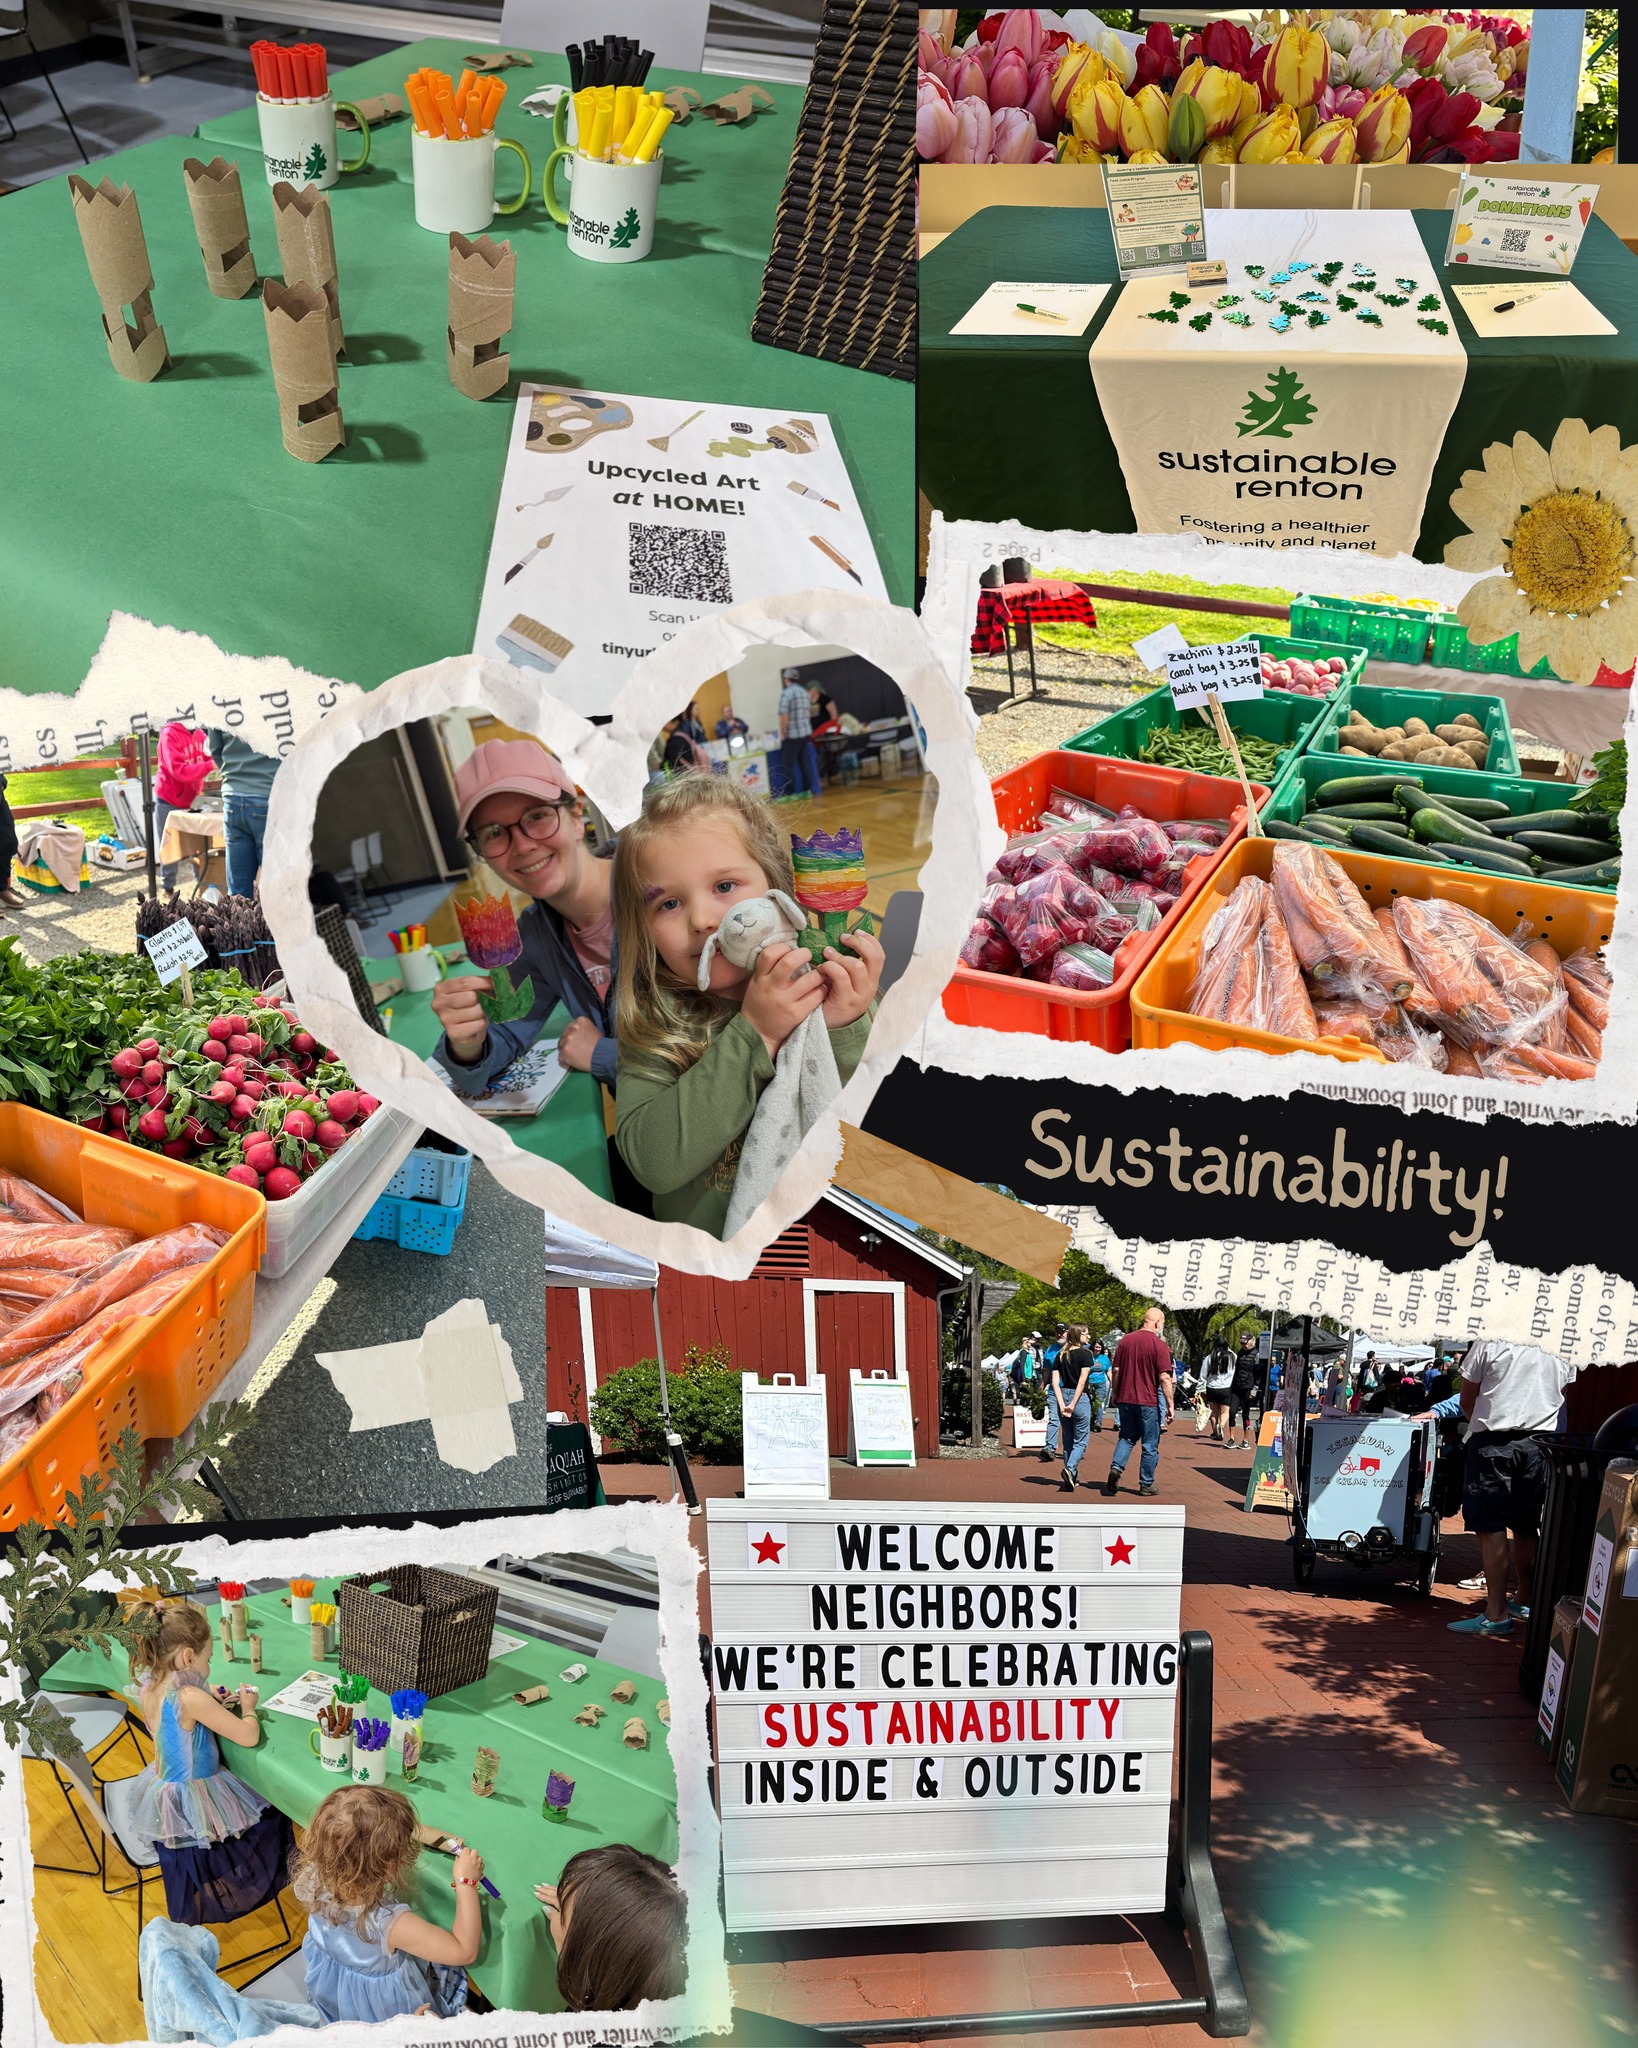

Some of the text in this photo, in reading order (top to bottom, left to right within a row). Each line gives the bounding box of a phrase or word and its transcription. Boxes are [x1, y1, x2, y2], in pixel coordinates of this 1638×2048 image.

[269, 165, 299, 179] renton
[1507, 185, 1542, 193] sustainable
[1478, 199, 1573, 219] DONATIONS
[571, 224, 604, 245] renton
[1158, 449, 1397, 476] sustainable
[588, 460, 761, 492] Upcycled Art
[1236, 476, 1363, 500] renton
[612, 491, 746, 517] at HOME!
[1180, 515, 1370, 534] Fostering a healthier
[1281, 536, 1315, 547] and
[649, 610, 685, 625] Scan
[602, 642, 657, 659] tinyur
[1197, 663, 1218, 675] bag
[1172, 683, 1198, 697] Radish
[1200, 681, 1219, 692] bag
[149, 931, 173, 948] Cilantro
[157, 957, 178, 974] Radish
[746, 1395, 823, 1408] CITY OF ISSAQUAH
[747, 1418, 821, 1450] FAIR
[1326, 1434, 1395, 1456] ISSAQUAH
[1314, 1476, 1404, 1488] ICE CREAM TRIKE
[1602, 1480, 1626, 1504] RECYCLE
[836, 1524, 1056, 1572] WELCOME
[811, 1584, 1078, 1630] NEIGHBORS!
[881, 1642, 1178, 1689] CELEBRATING
[765, 1698, 1121, 1748] SUSTAINABILITY
[745, 1752, 1143, 1805] INSIDE & OUTSIDE
